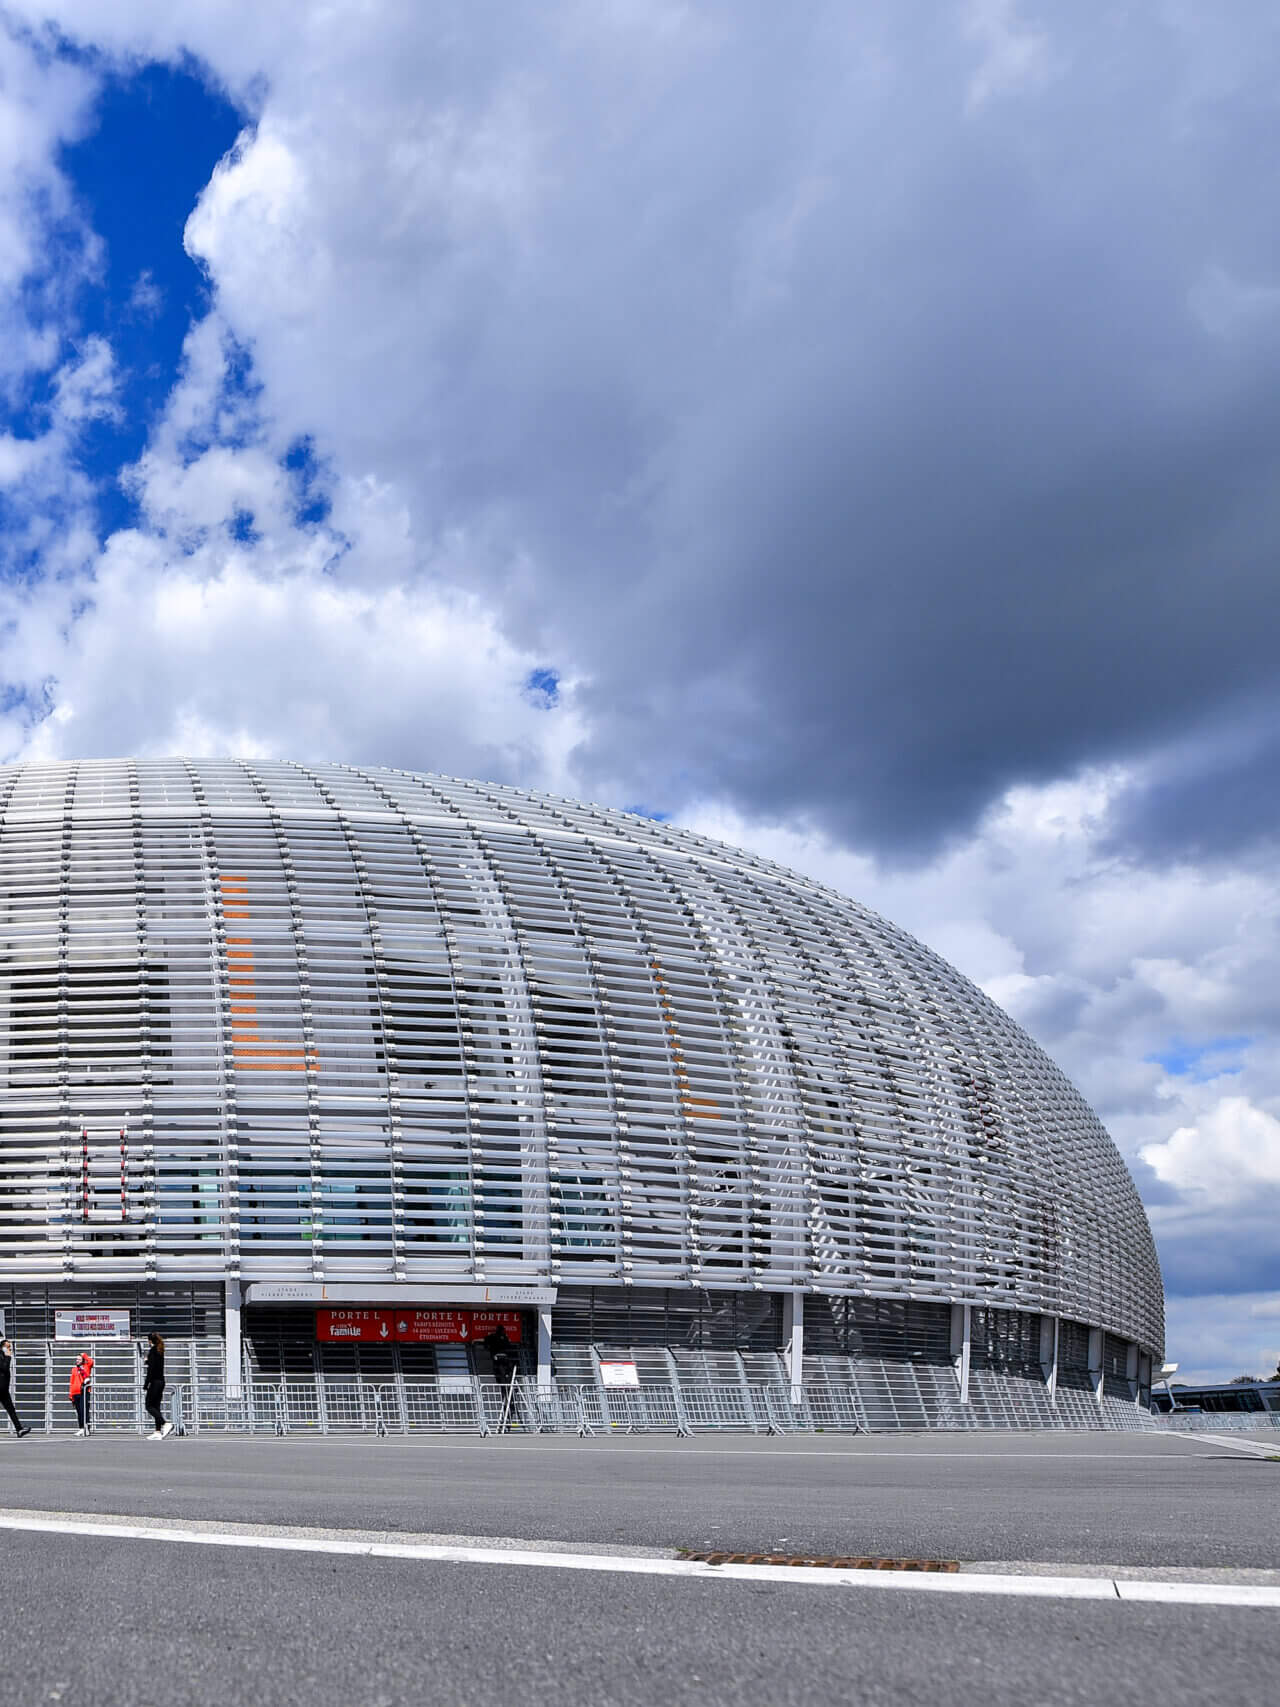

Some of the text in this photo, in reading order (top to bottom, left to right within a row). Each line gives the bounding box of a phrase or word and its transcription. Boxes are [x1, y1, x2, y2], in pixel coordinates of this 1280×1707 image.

[322, 1285, 328, 1299] L
[485, 1288, 491, 1301] L
[331, 1311, 380, 1320] PORTE L
[415, 1311, 463, 1320] PORTE L
[473, 1312, 519, 1321] PORTE L
[329, 1324, 361, 1336] famille
